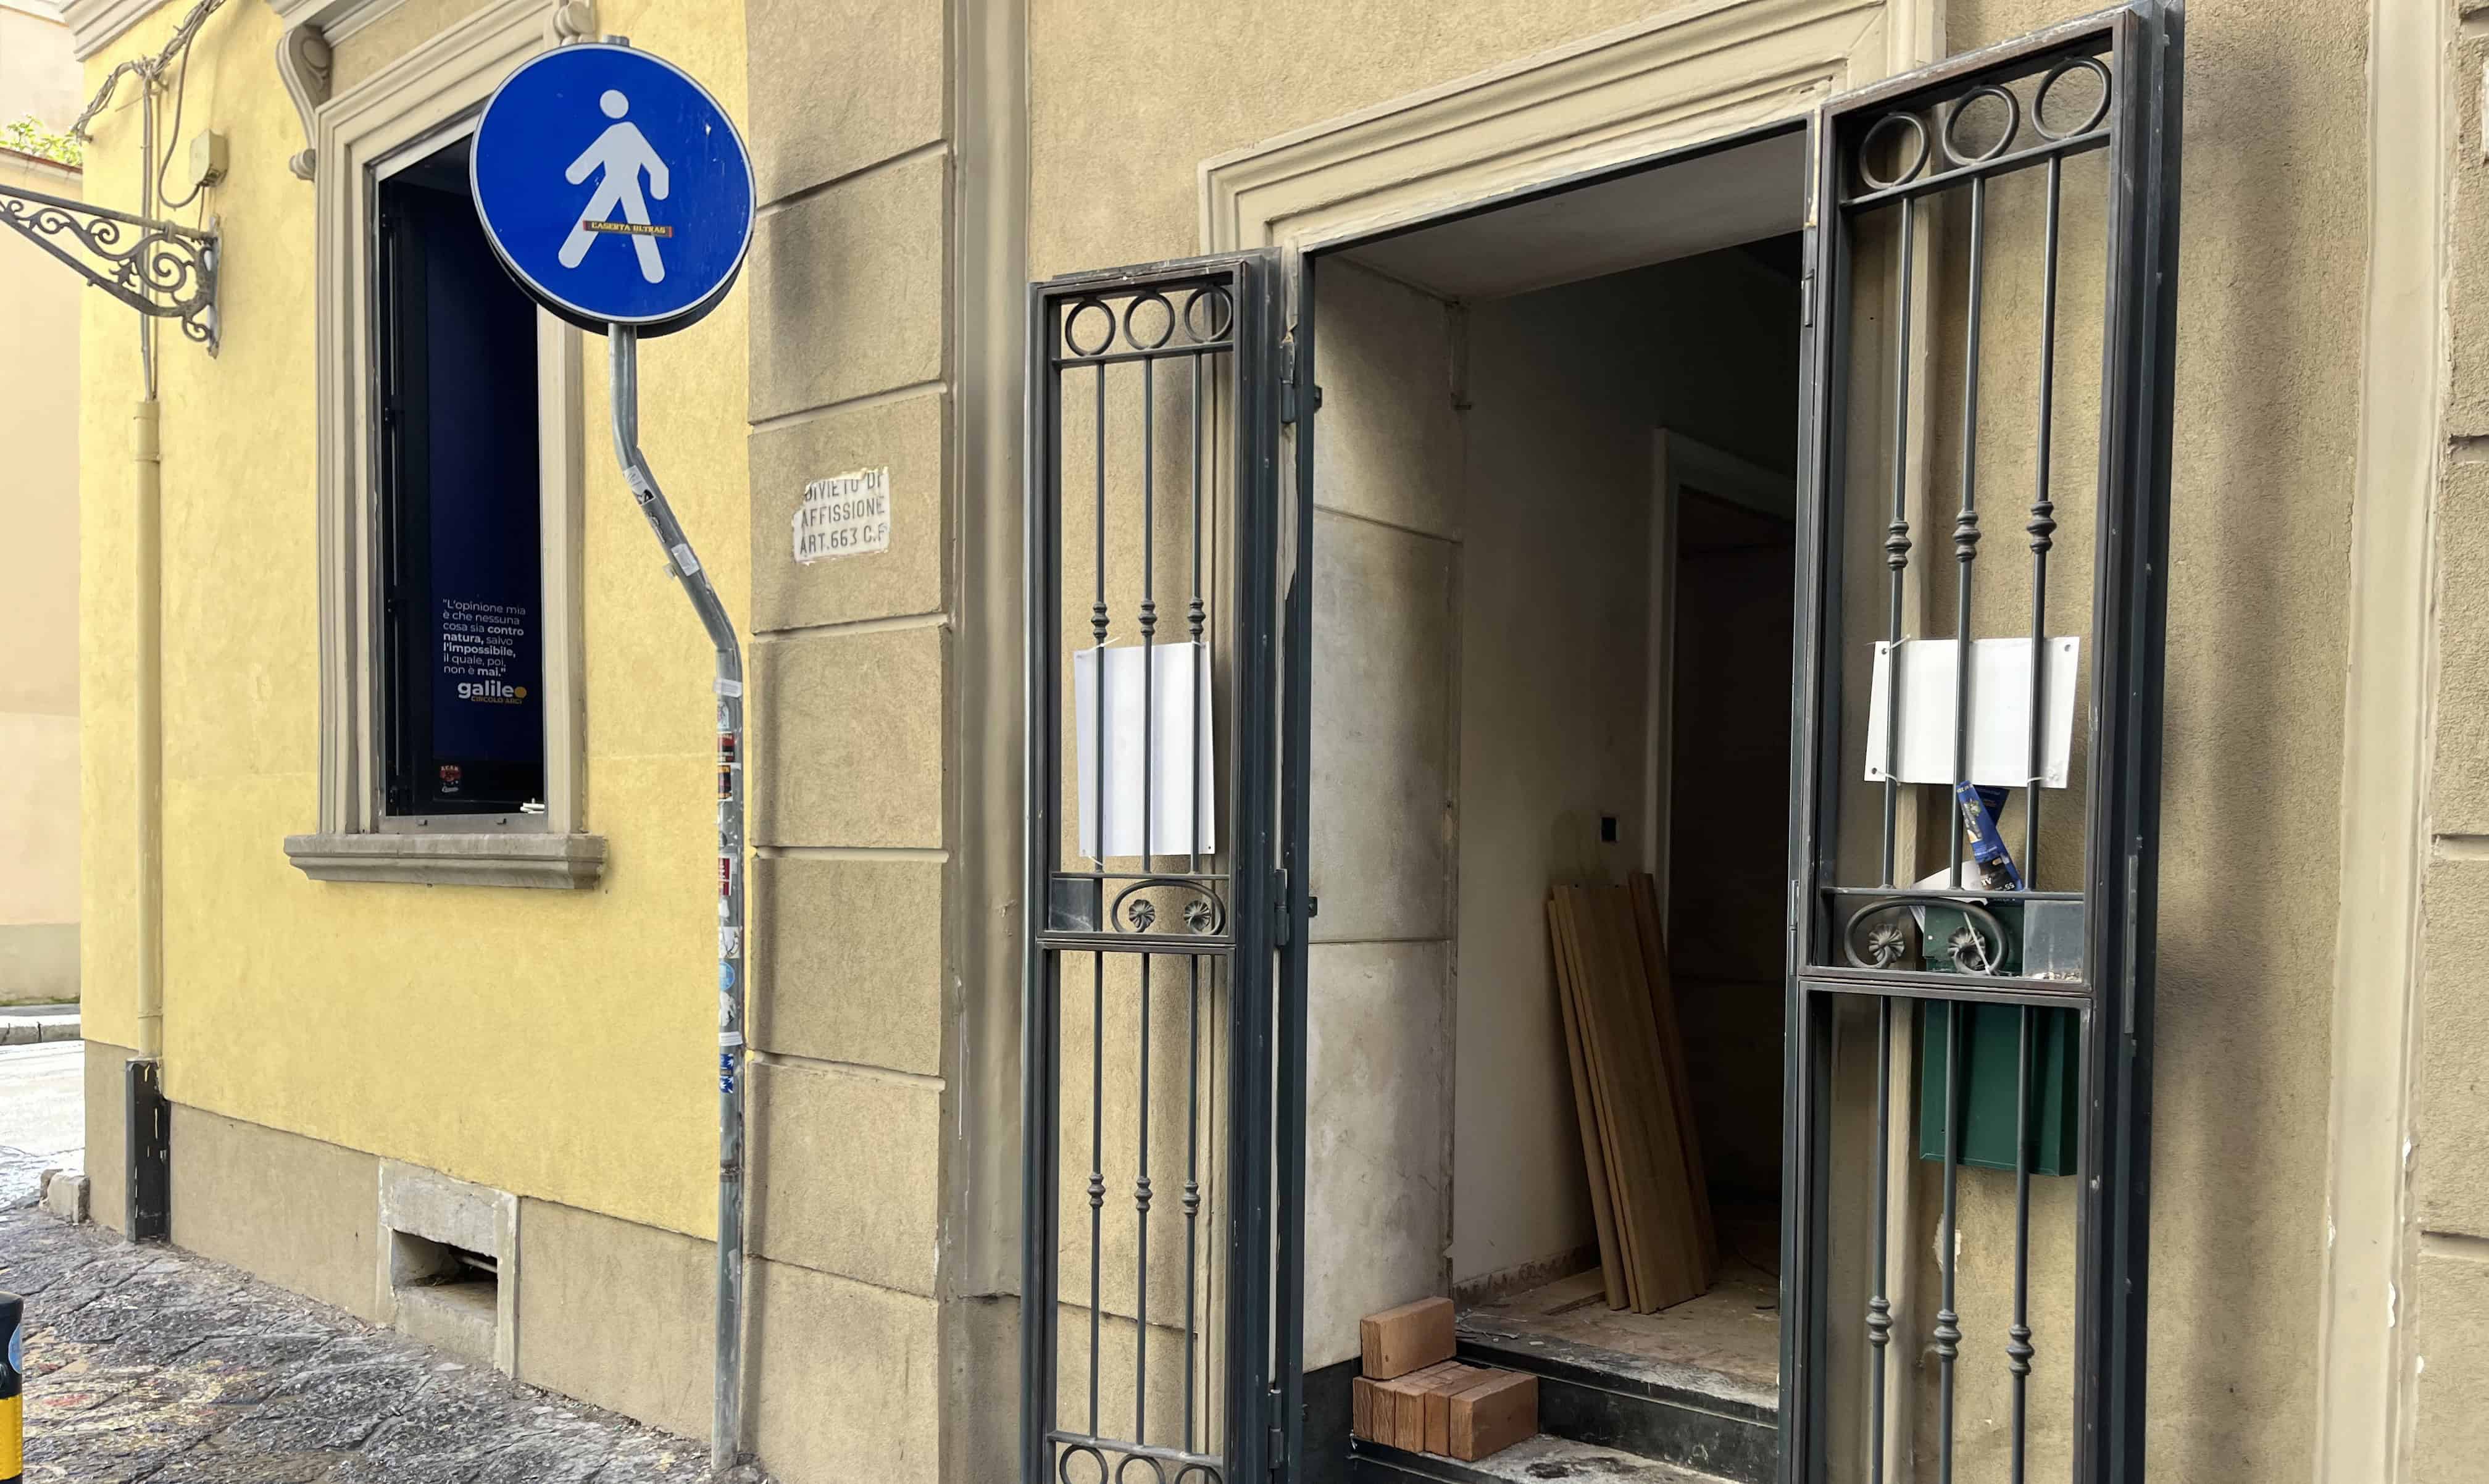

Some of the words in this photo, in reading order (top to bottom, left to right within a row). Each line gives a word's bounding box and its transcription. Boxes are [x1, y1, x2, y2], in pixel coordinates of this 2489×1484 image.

[867, 472, 881, 490] DI
[801, 496, 885, 528] AFFISSIONE
[443, 609, 449, 619] è
[452, 611, 472, 621] che
[475, 614, 520, 625] nessuna
[506, 606, 526, 615] mia
[443, 622, 467, 632] cosa
[470, 623, 485, 633] sia
[487, 625, 524, 636] contro
[443, 633, 484, 644] natura,
[486, 636, 513, 646] salvo
[443, 652, 449, 662] il
[452, 654, 485, 666] quale,
[487, 657, 506, 667] poi,
[444, 665, 465, 674] non
[468, 665, 475, 675] è
